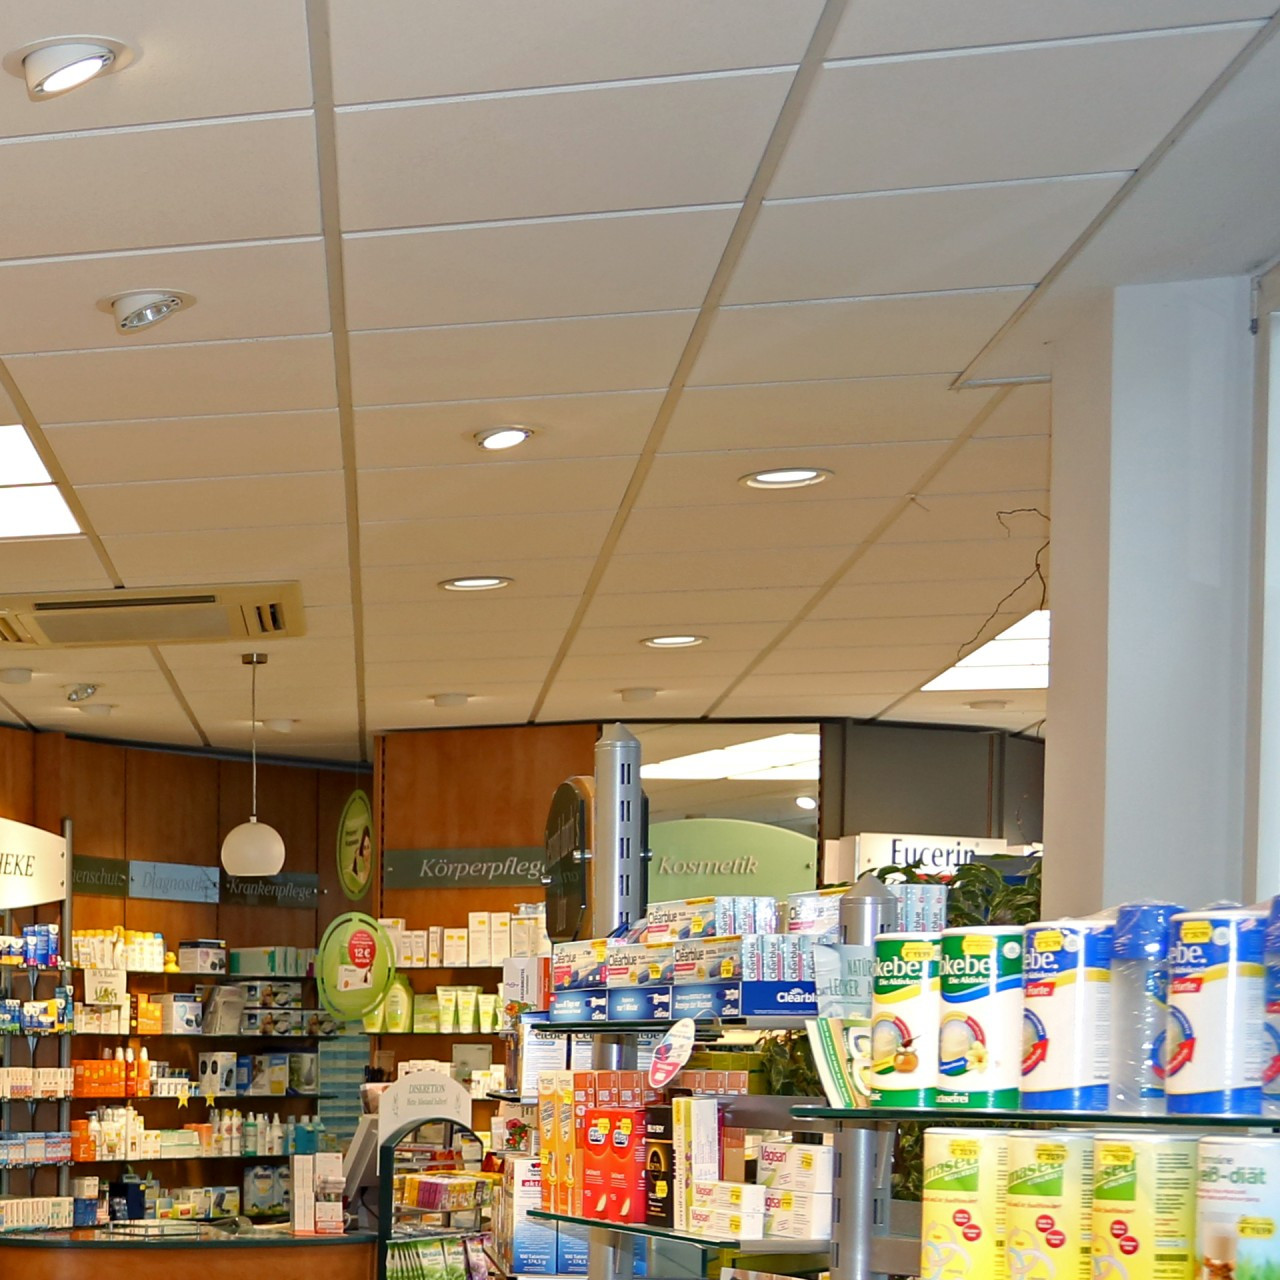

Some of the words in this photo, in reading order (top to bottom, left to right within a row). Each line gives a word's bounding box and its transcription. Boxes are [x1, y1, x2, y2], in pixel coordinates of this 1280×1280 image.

[891, 837, 976, 867] Eucerin
[658, 854, 760, 878] Kosmetik
[229, 880, 314, 901] Krankenpflege
[649, 909, 678, 925] Clearblue
[354, 947, 364, 958] 12
[364, 947, 371, 958] €
[608, 952, 638, 967] Clearblue
[674, 947, 705, 963] Clearblue
[749, 941, 757, 980] Clearblue
[770, 941, 778, 980] Clearblue
[791, 941, 799, 979] Clearblue
[776, 991, 815, 1003] Clearbl
[760, 1145, 787, 1165] Vagisan
[695, 1184, 714, 1198] Vagisan
[691, 1209, 711, 1224] Vagisan
